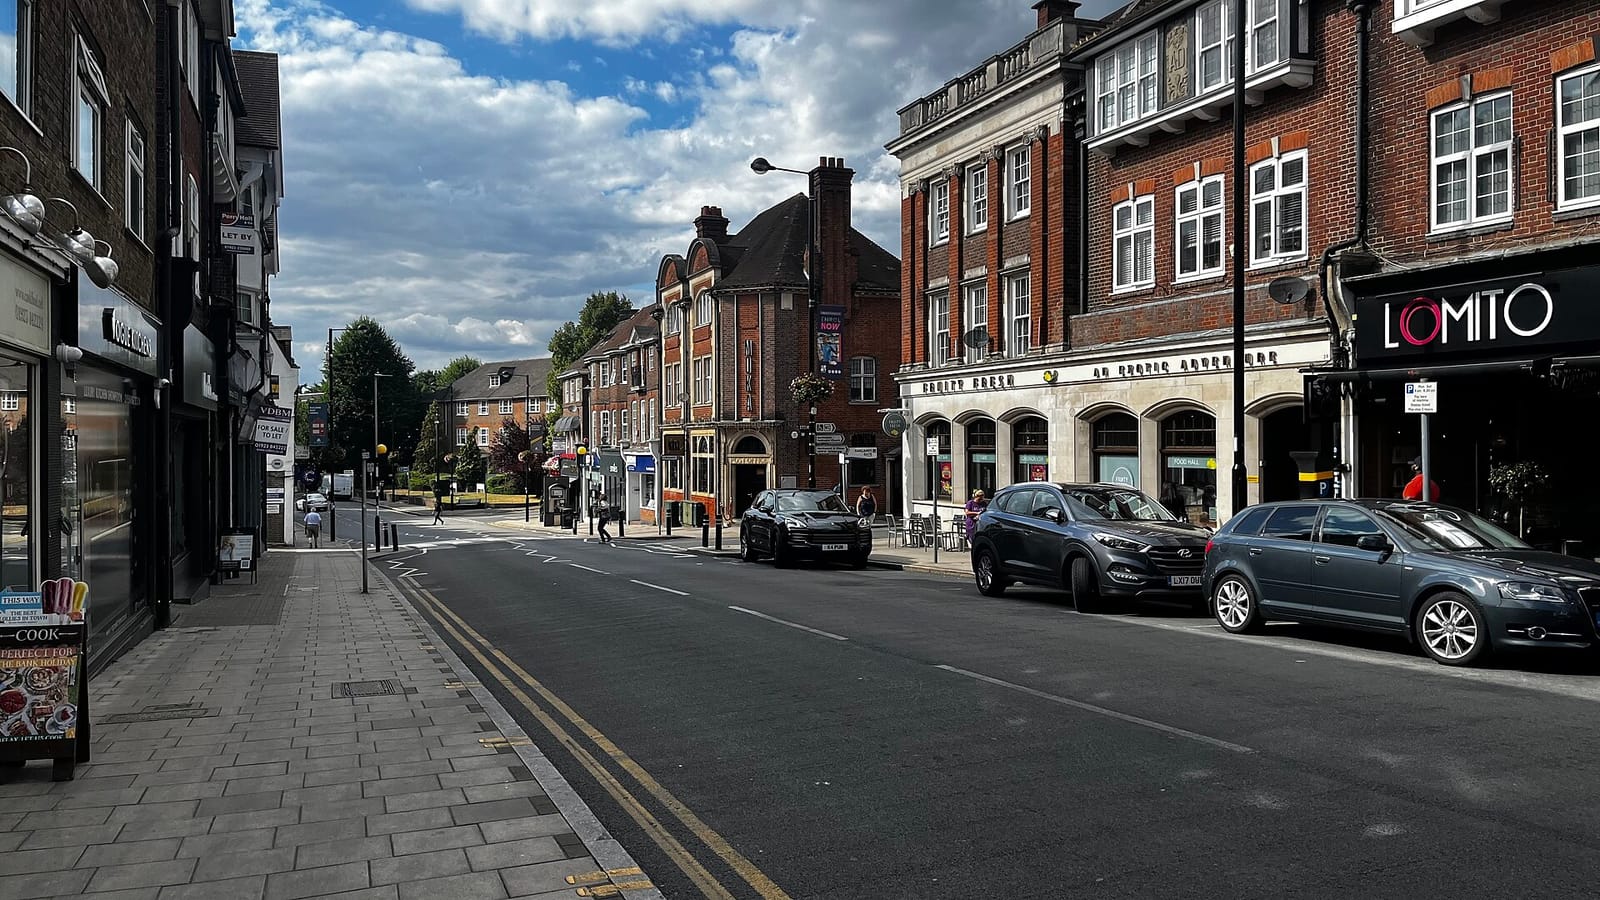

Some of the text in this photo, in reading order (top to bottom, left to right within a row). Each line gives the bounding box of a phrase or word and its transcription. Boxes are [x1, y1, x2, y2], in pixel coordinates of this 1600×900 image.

[222, 231, 238, 239] LET
[1384, 283, 1554, 349] LOMITO
[820, 322, 841, 330] NOW
[1181, 351, 1278, 371] ADVENURE
[922, 375, 1015, 394] FRUITY FRESH
[260, 406, 291, 417] VDBM
[257, 424, 269, 433] FOR
[262, 431, 271, 439] TO
[16, 628, 59, 641] COOK
[1, 648, 73, 658] PERFECT FOR
[41, 658, 75, 666] HOLIDAY
